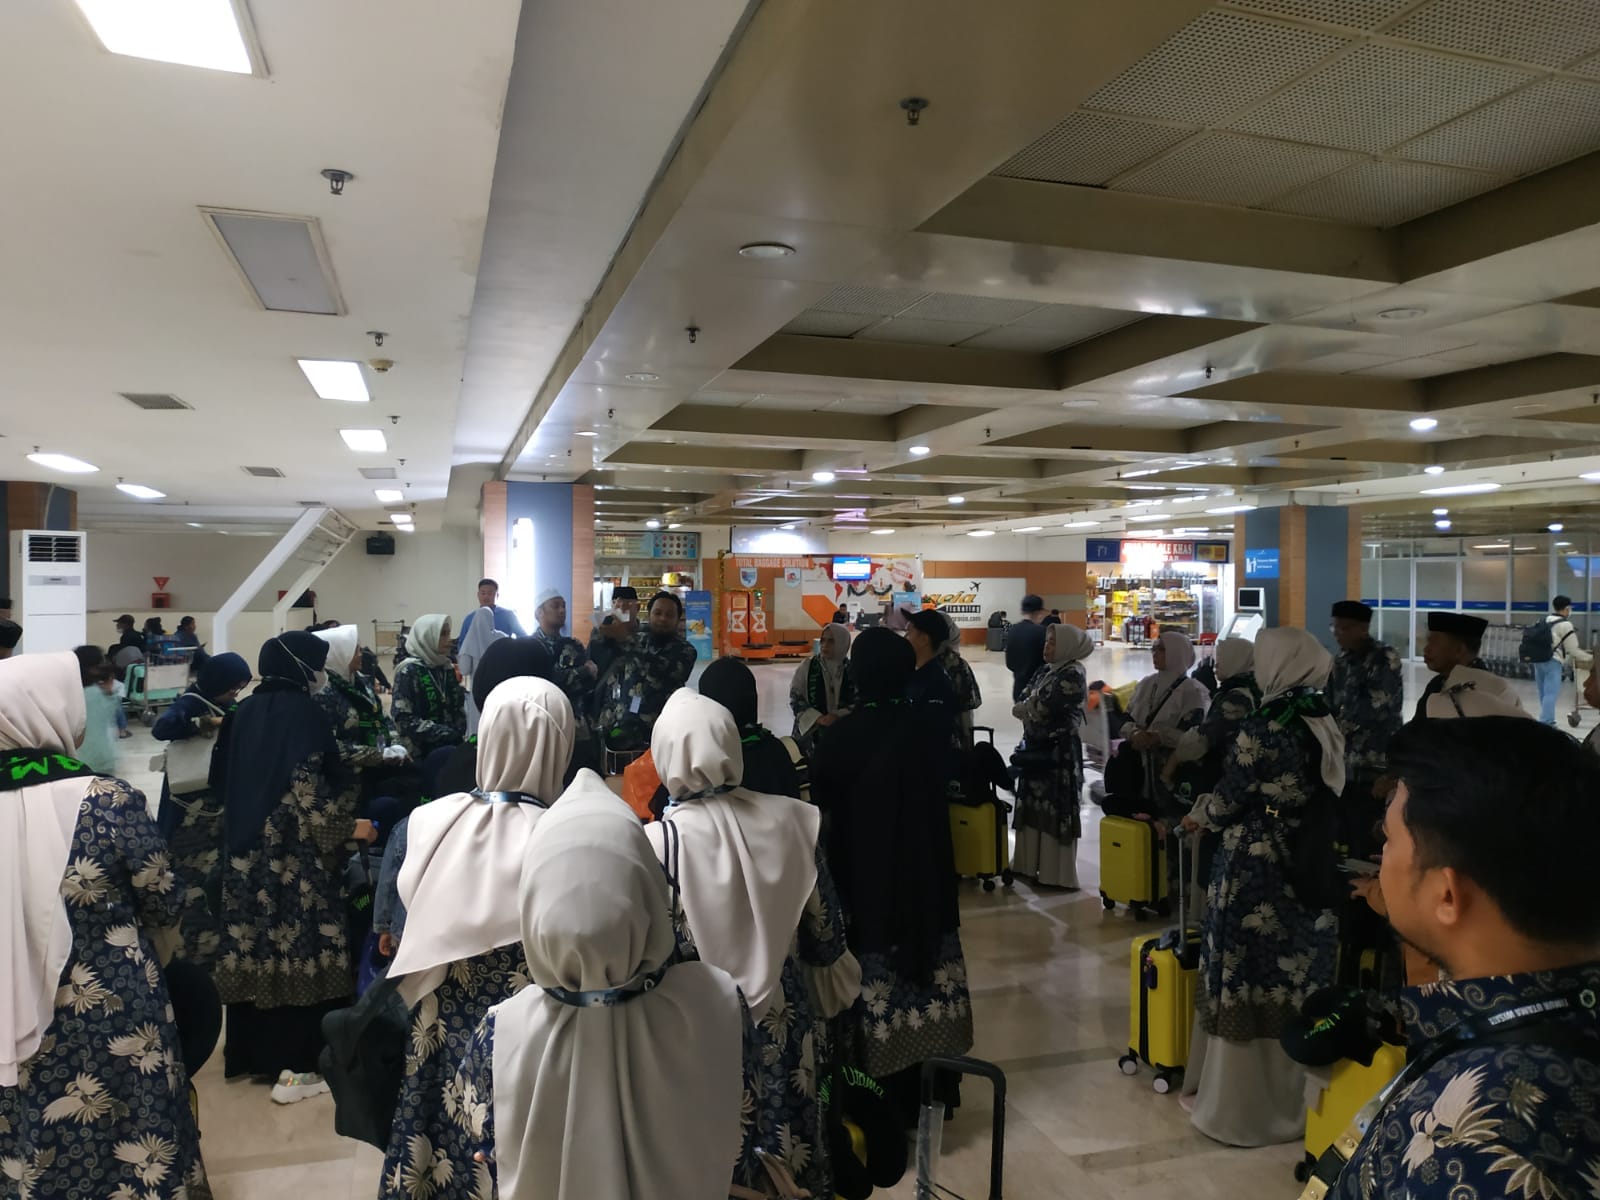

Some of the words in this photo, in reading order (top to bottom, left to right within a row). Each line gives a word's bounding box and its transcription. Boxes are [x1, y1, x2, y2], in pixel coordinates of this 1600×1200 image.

[736, 558, 752, 568] TOTAL
[753, 558, 780, 568] BAGGAGE
[782, 558, 809, 568] SOLUTION
